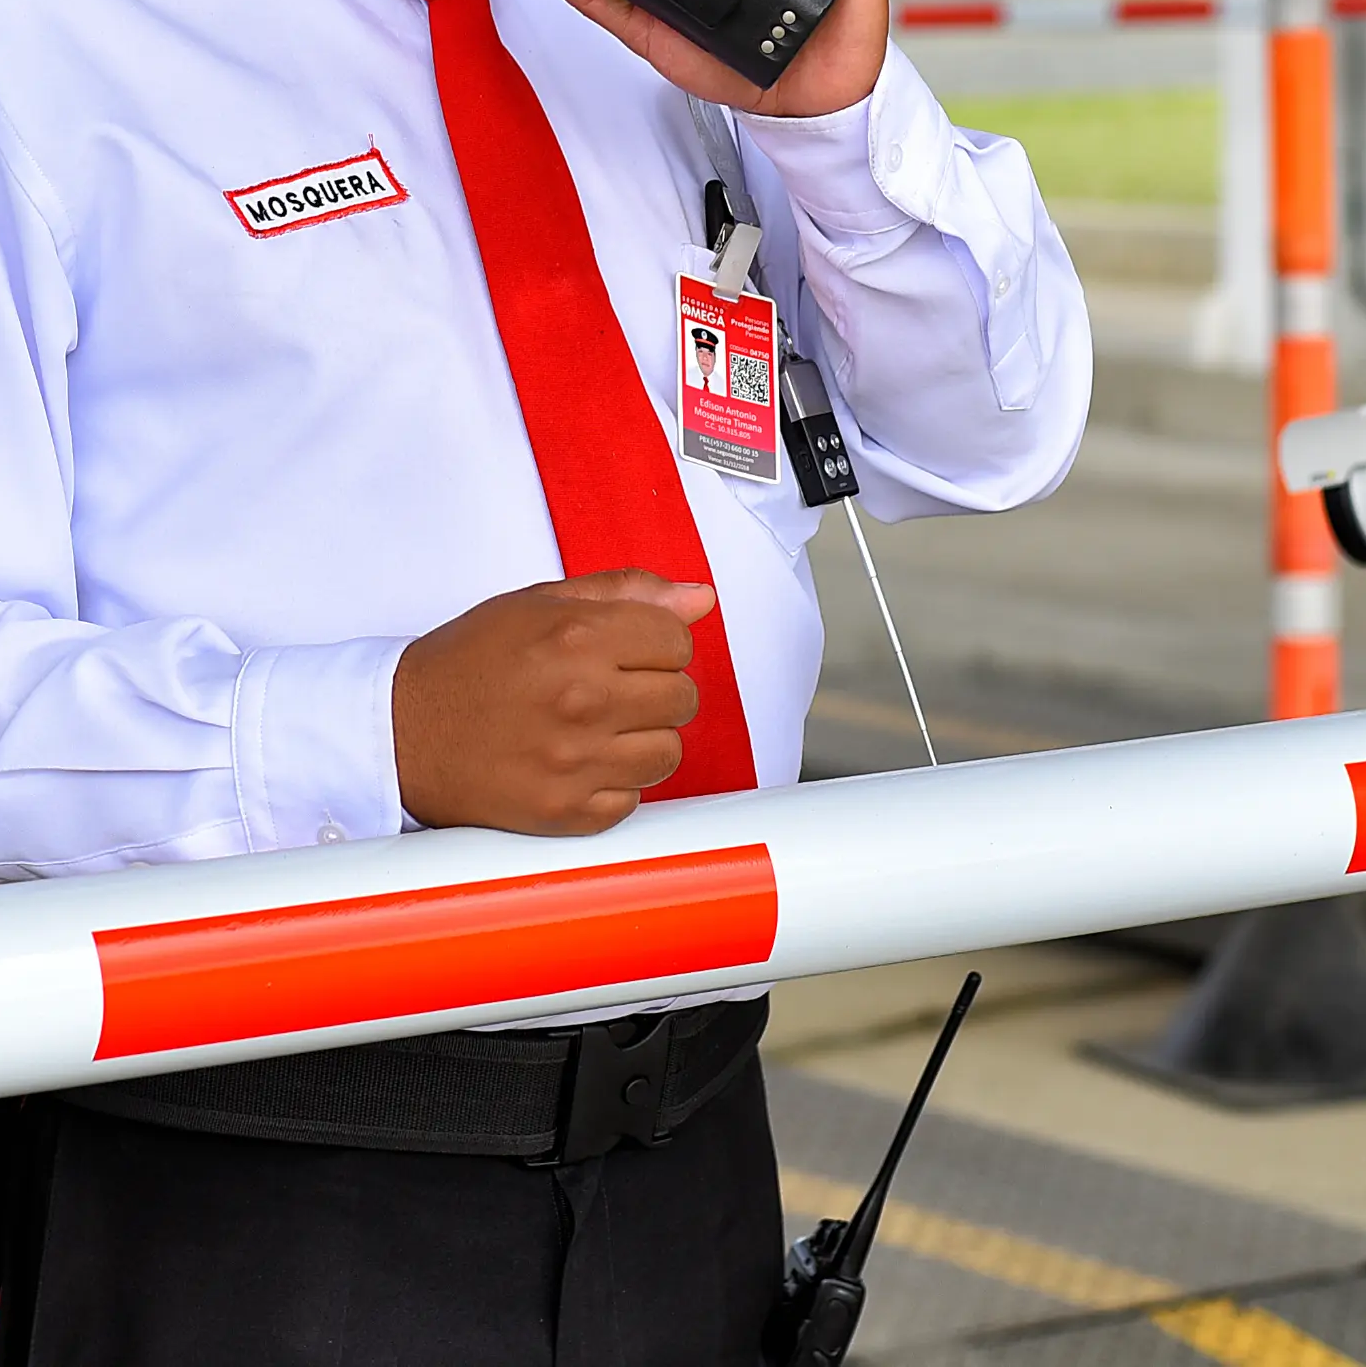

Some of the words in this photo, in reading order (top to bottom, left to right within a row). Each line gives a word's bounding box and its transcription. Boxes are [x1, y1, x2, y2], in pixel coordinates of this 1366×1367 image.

[246, 171, 386, 223] MOSQUERA
[682, 295, 724, 315] SEGURIDAD
[681, 303, 726, 328] OMEGA
[745, 316, 769, 327] Personas
[731, 318, 769, 334] Protegiendo
[745, 330, 769, 342] Personas
[694, 406, 732, 425] Mosquera
[733, 418, 763, 433] Timana
[699, 397, 724, 413] Edison
[726, 406, 757, 422] Antonio
[704, 421, 717, 430] C.C.
